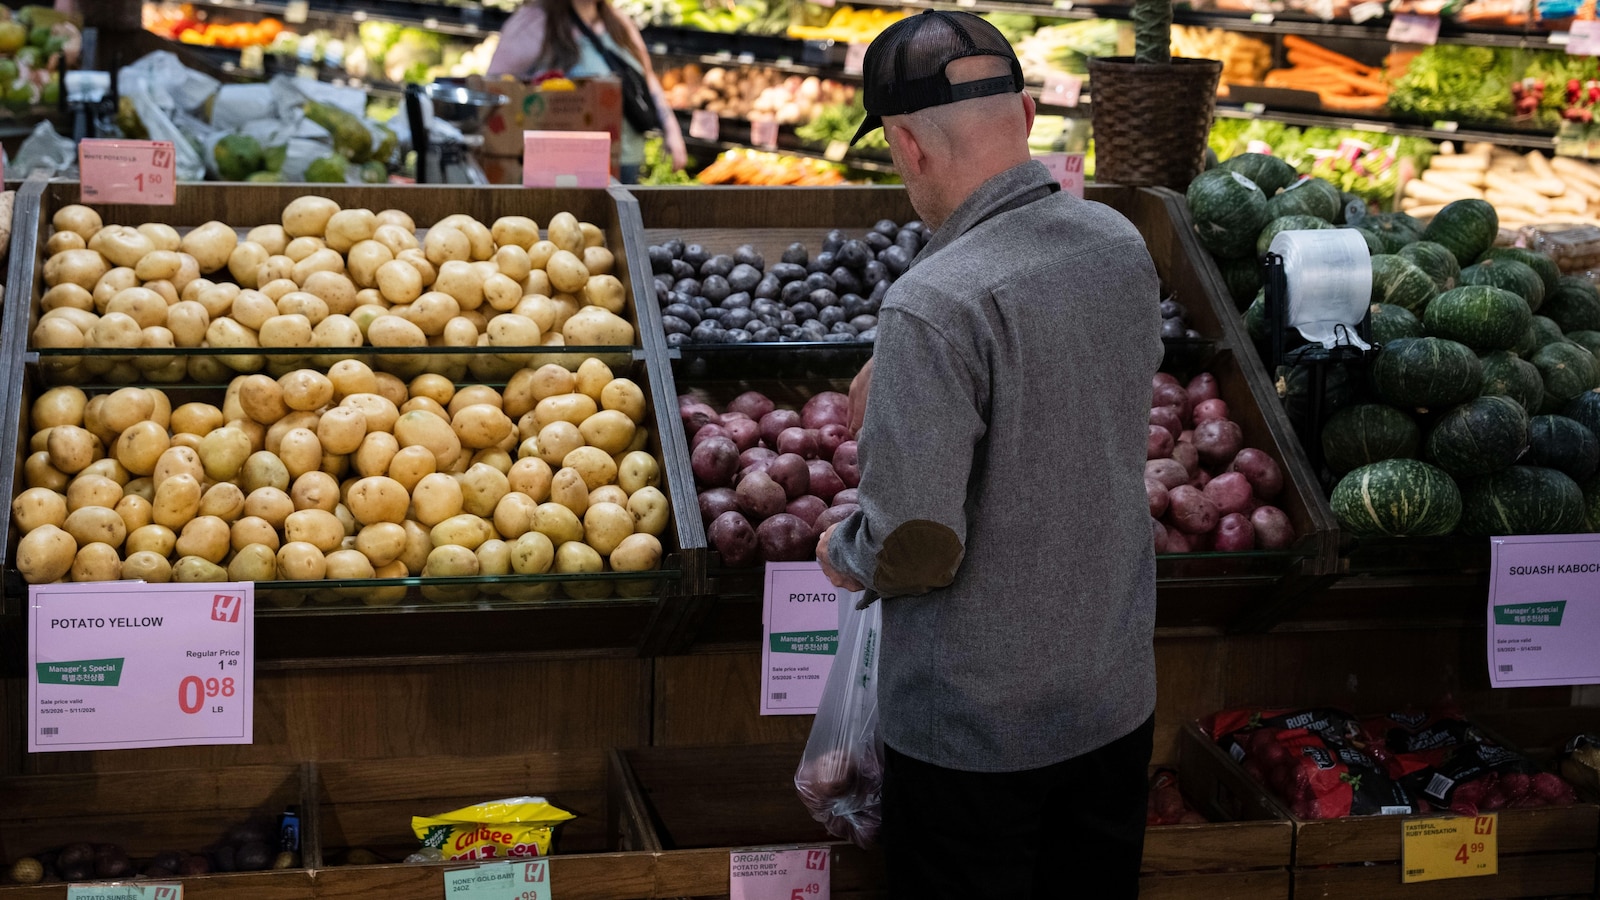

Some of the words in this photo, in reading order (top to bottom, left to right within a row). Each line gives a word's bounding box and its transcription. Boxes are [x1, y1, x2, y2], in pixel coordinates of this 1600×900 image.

[134, 173, 144, 192] 1
[149, 174, 162, 184] 50
[1510, 565, 1554, 576] SQUASH
[790, 593, 836, 602] POTATO
[1536, 606, 1558, 614] Special
[51, 618, 105, 629] POTATO
[109, 616, 164, 628] YELLOW
[186, 650, 218, 658] Regular
[88, 664, 116, 673] Special
[218, 660, 224, 670] 1
[62, 674, 104, 682] 특별추천상품
[1286, 712, 1314, 730] RUBY
[455, 824, 513, 850] Calbee
[1424, 828, 1457, 836] SENSATION
[1455, 844, 1470, 864] 4
[1470, 842, 1484, 853] 99
[733, 854, 776, 863] ORGANIC
[452, 878, 476, 886] HONEY
[497, 872, 515, 880] BABY
[805, 883, 820, 894] 49
[522, 891, 537, 900] 99
